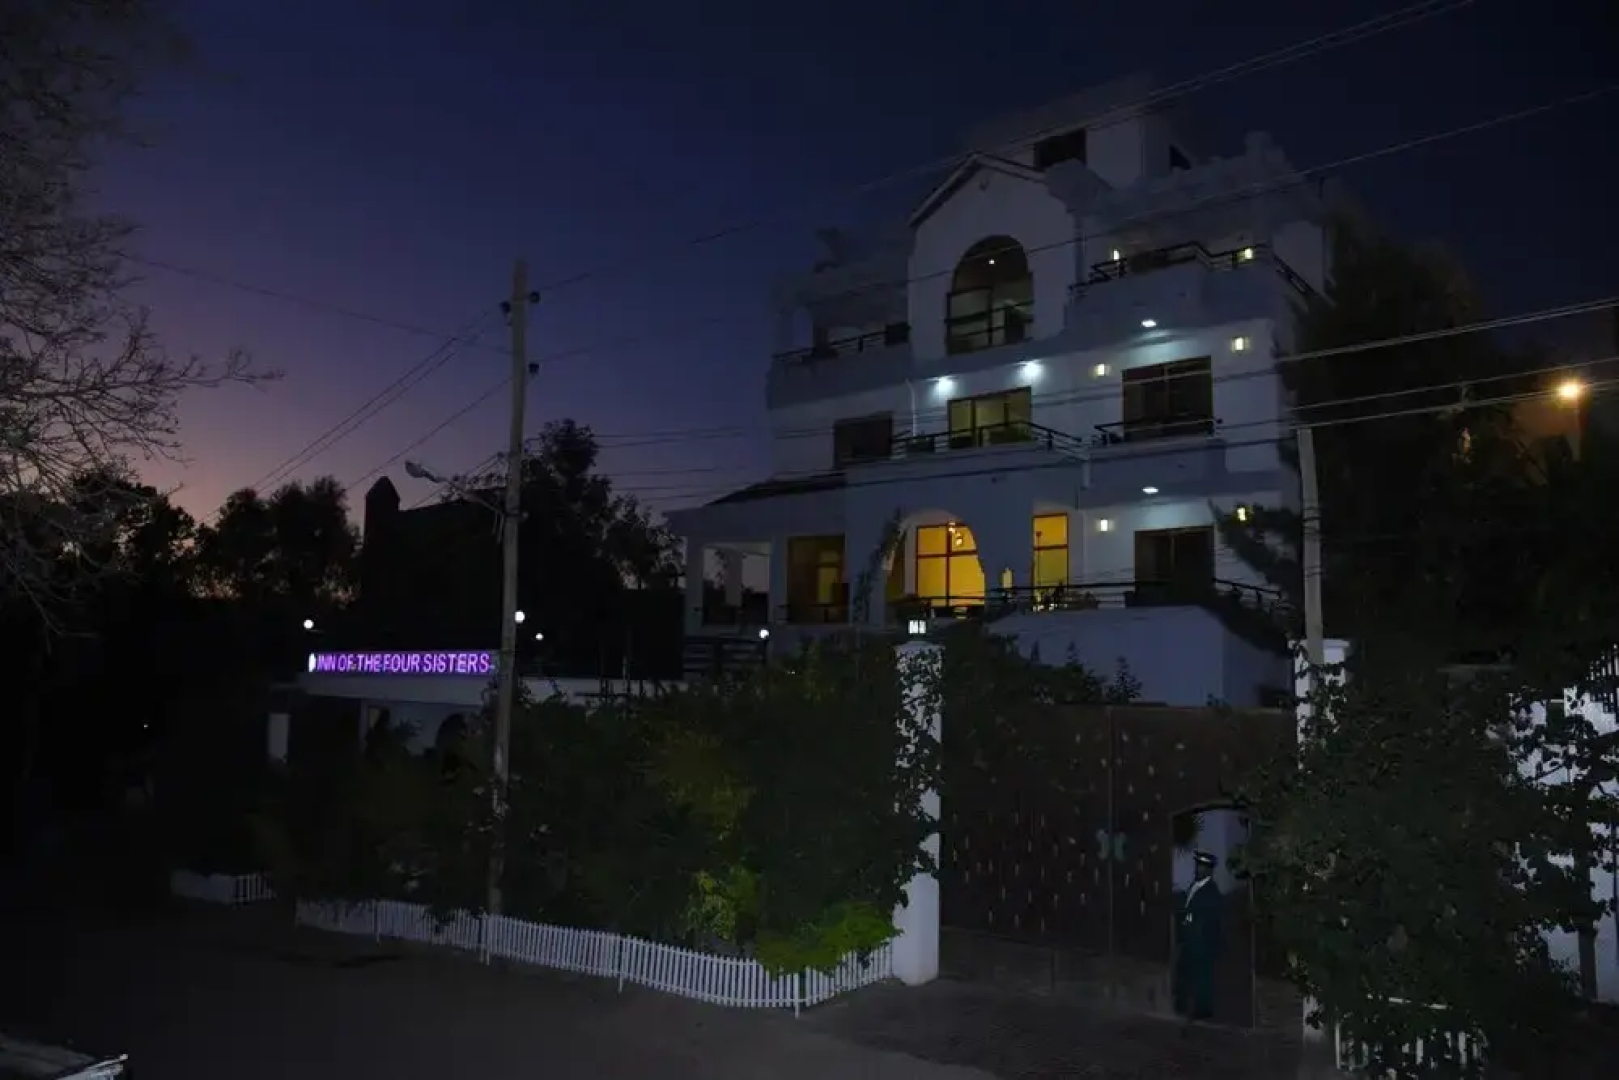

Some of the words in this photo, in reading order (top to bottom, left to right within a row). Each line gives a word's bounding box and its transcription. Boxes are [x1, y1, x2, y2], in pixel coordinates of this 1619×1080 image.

[316, 653, 336, 671] INN
[338, 653, 353, 671] OF
[357, 653, 381, 672] THE
[384, 653, 420, 673] FOUR
[423, 653, 490, 673] SISTERS
